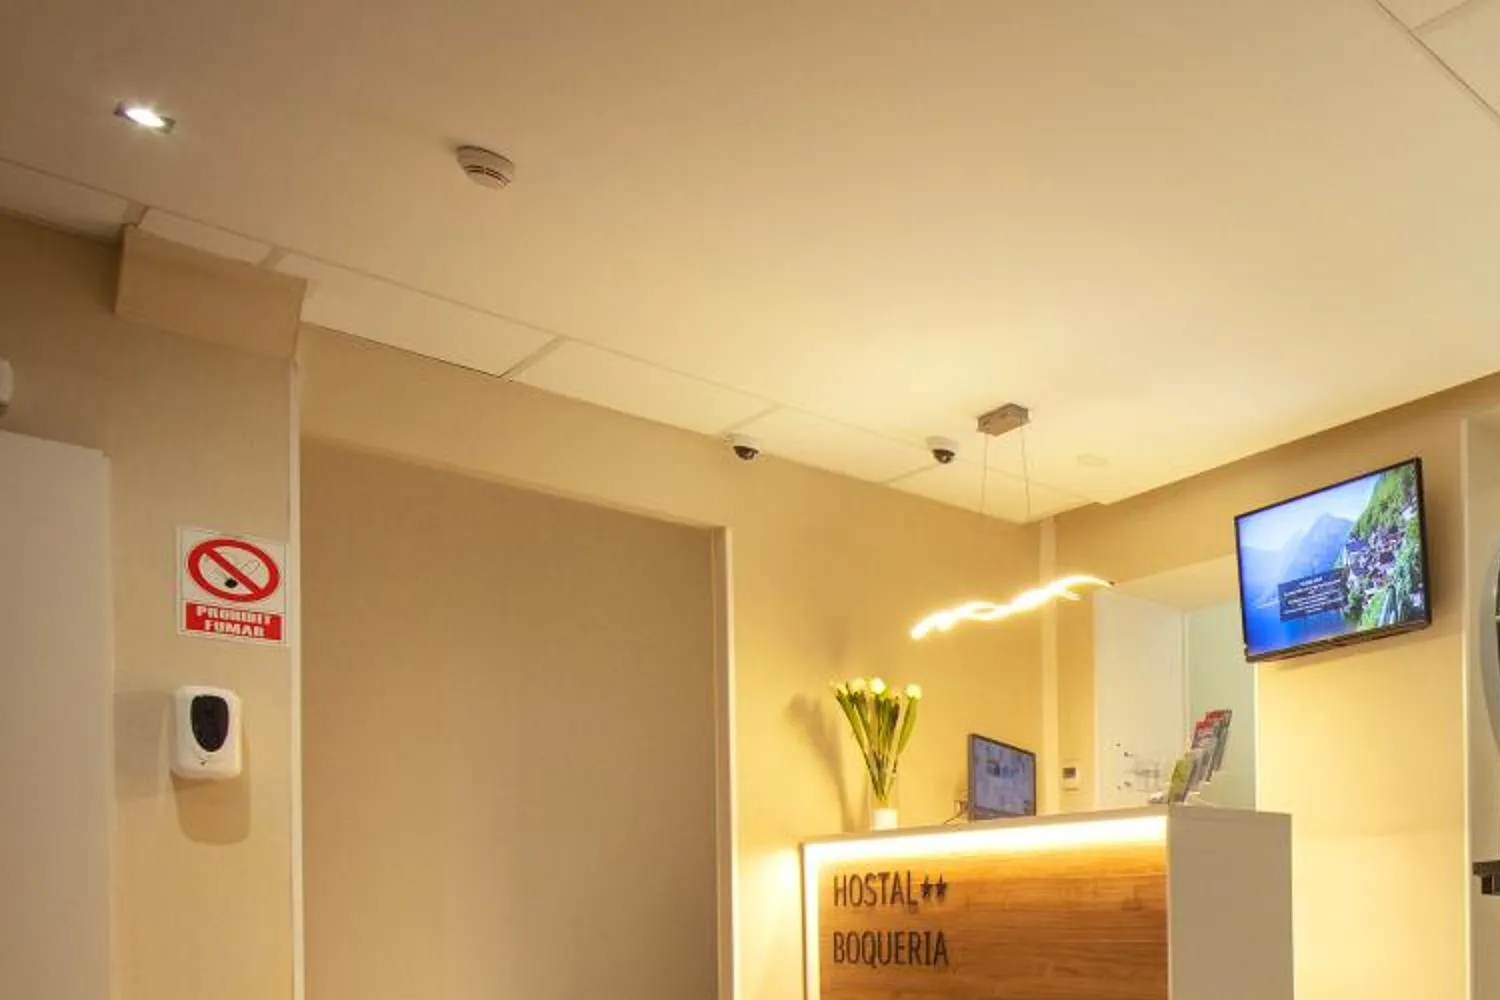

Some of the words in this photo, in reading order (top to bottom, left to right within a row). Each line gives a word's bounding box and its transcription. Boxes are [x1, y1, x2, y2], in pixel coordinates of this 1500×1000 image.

[204, 620, 264, 638] FUMAR
[833, 870, 918, 908] HOSTAL
[833, 930, 949, 968] BOQUERIA
